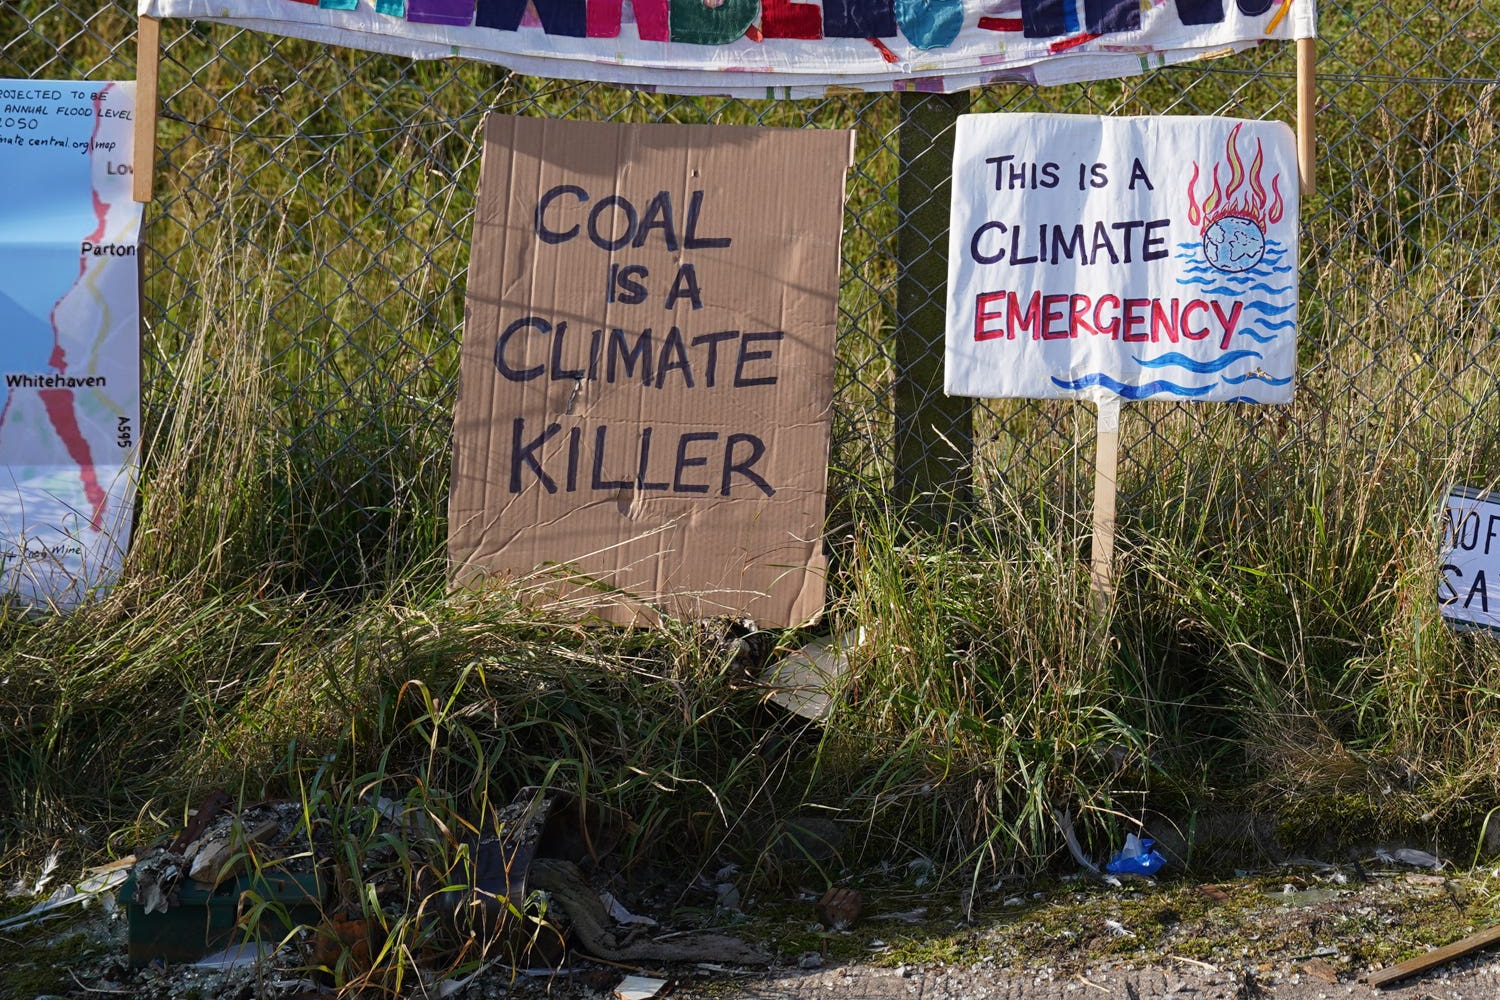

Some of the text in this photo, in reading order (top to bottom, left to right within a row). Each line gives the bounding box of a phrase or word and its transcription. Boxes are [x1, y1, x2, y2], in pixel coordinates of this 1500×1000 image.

[4, 104, 133, 121] ANNUAL FLOOD LEVEL
[71, 91, 85, 100] TO
[90, 91, 108, 101] BE
[107, 161, 134, 176] Lo
[986, 155, 1154, 191] THIS IS A
[534, 184, 732, 252] COAL
[81, 241, 135, 257] Parton
[970, 219, 1171, 267] CLIMATE
[607, 263, 704, 310] IS A
[974, 290, 1243, 350] EMERGENCY
[493, 316, 784, 390] CLIMATE
[6, 373, 106, 388] Whitehaven
[117, 416, 132, 448] A595
[509, 417, 777, 497] KILLER
